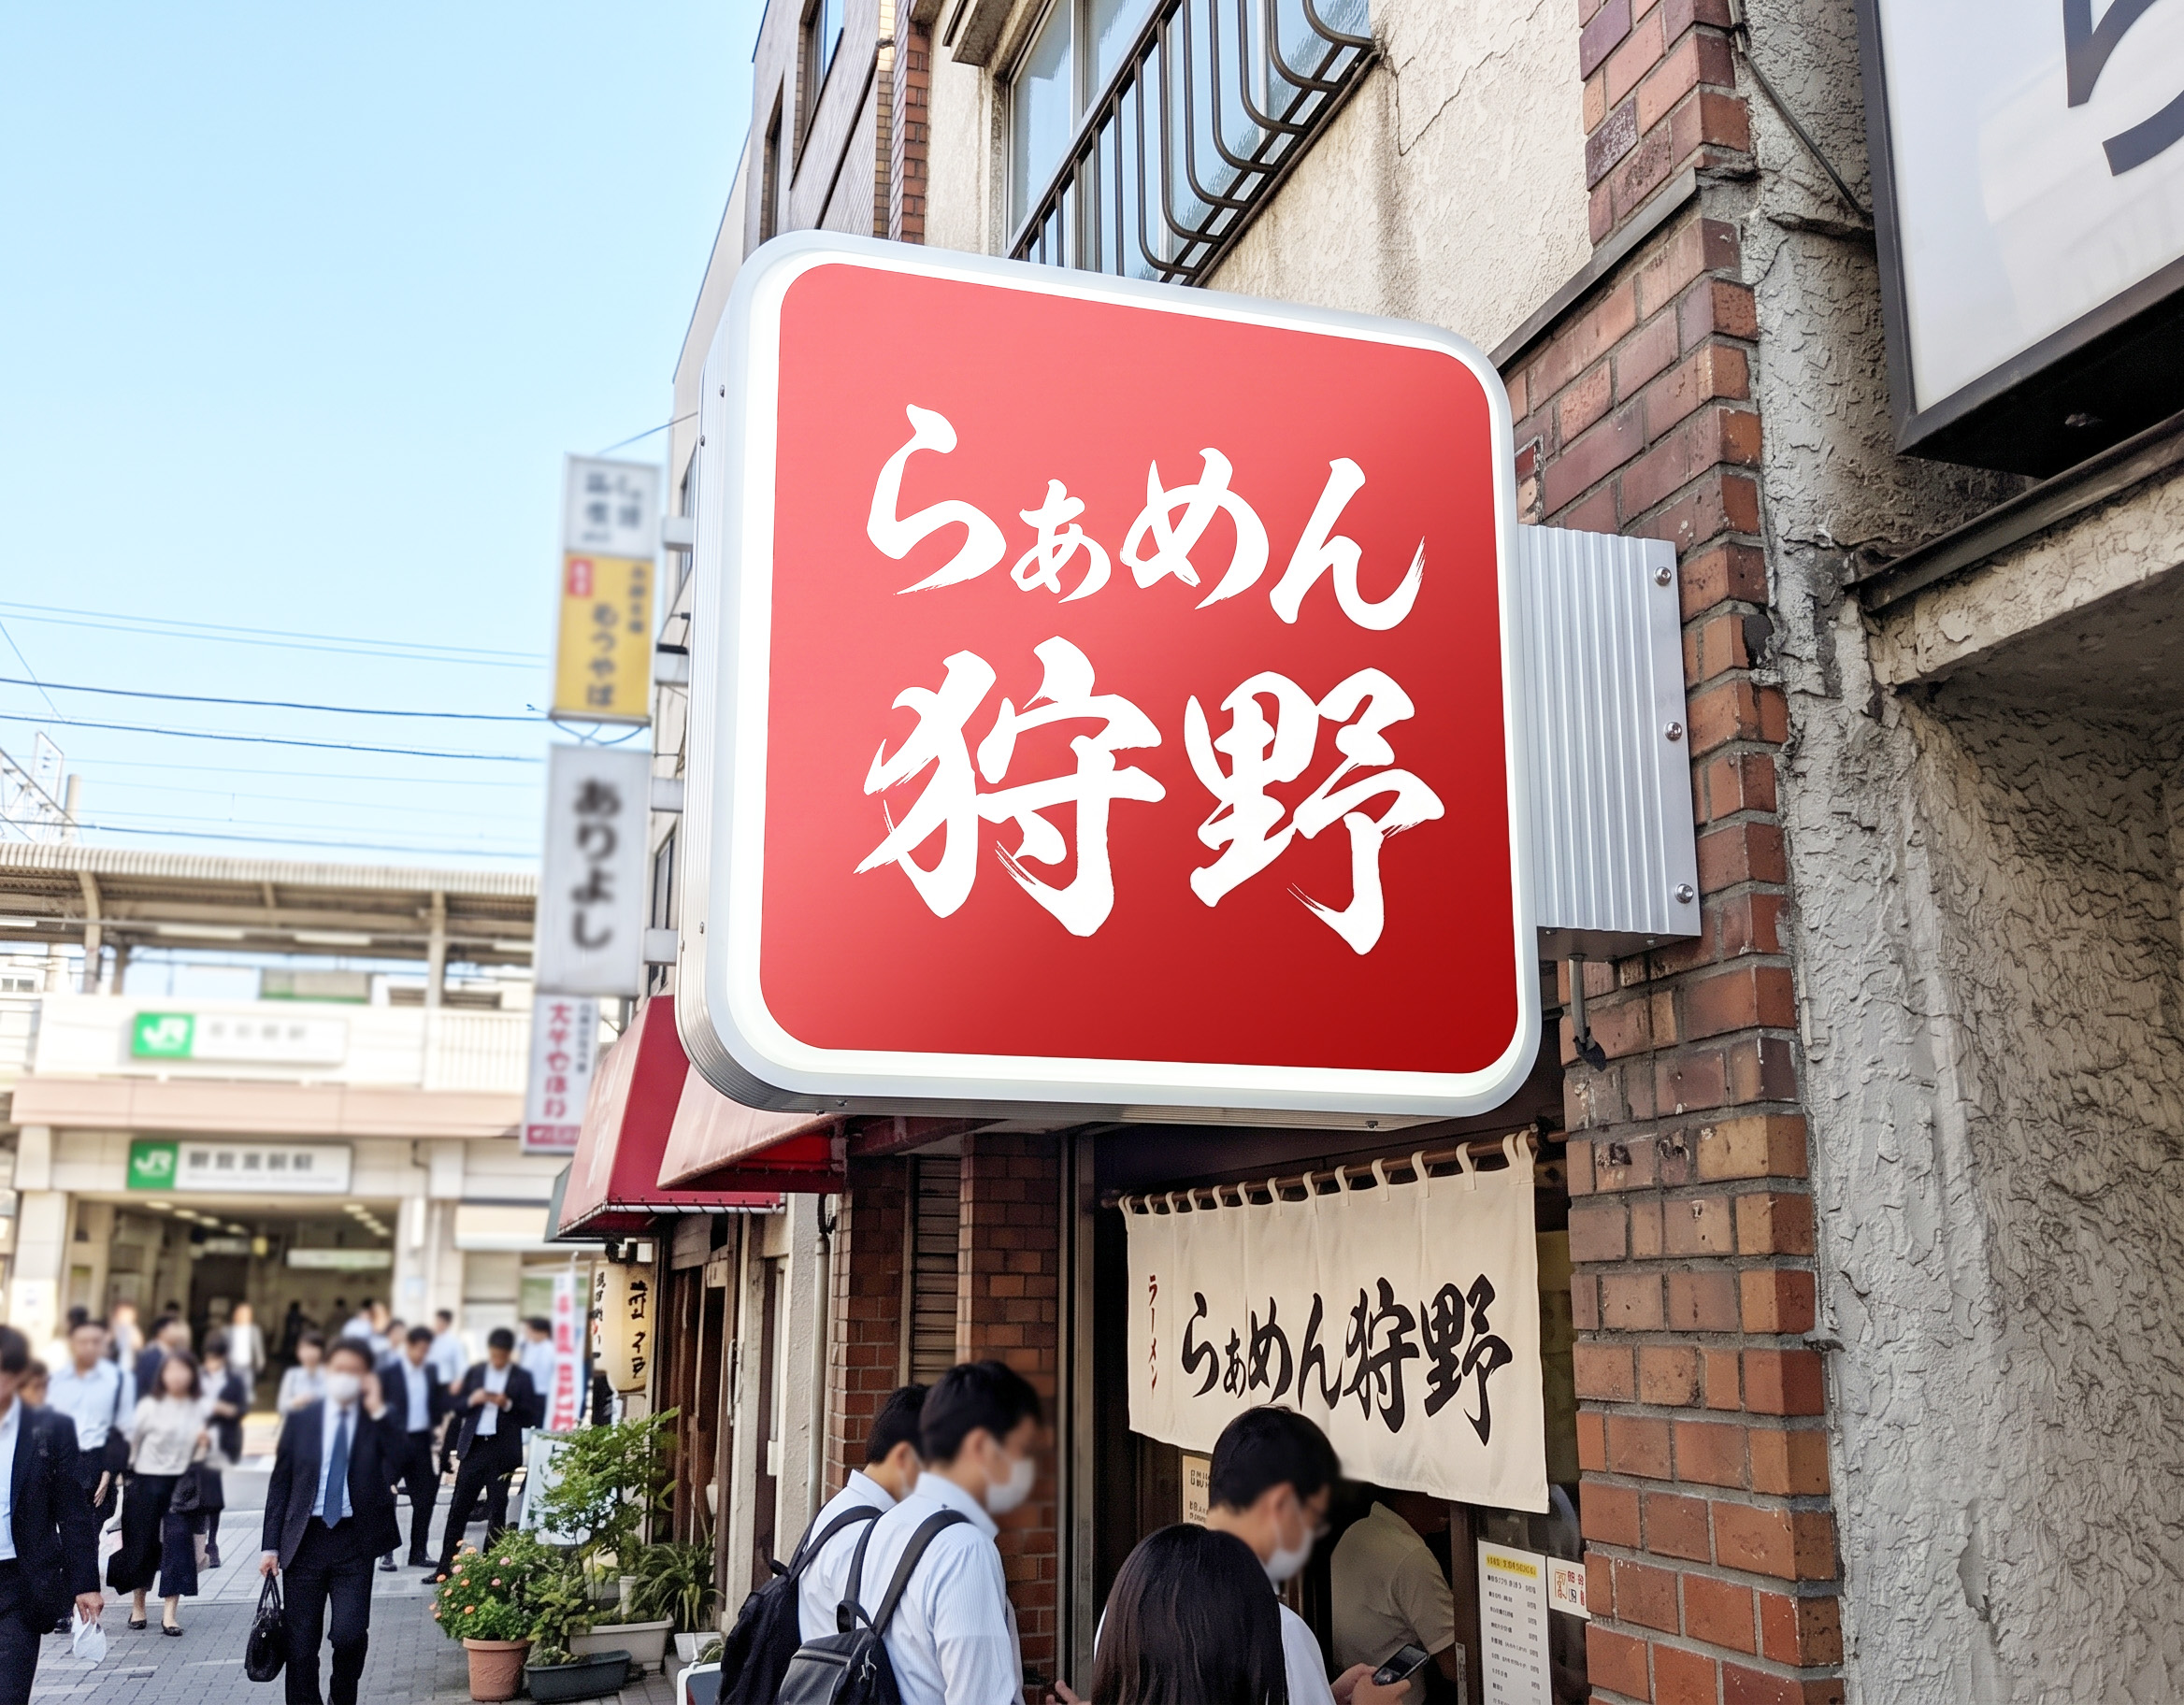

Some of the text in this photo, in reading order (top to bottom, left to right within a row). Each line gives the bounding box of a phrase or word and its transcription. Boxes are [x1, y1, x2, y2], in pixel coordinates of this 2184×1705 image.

[866, 403, 1427, 631] らぁめん
[853, 636, 1446, 955] 狩野
[142, 1017, 188, 1044] JR
[134, 1151, 172, 1172] JR
[1147, 1274, 1158, 1395] ラーメン
[1181, 1273, 1514, 1447] らぁめん狩野
